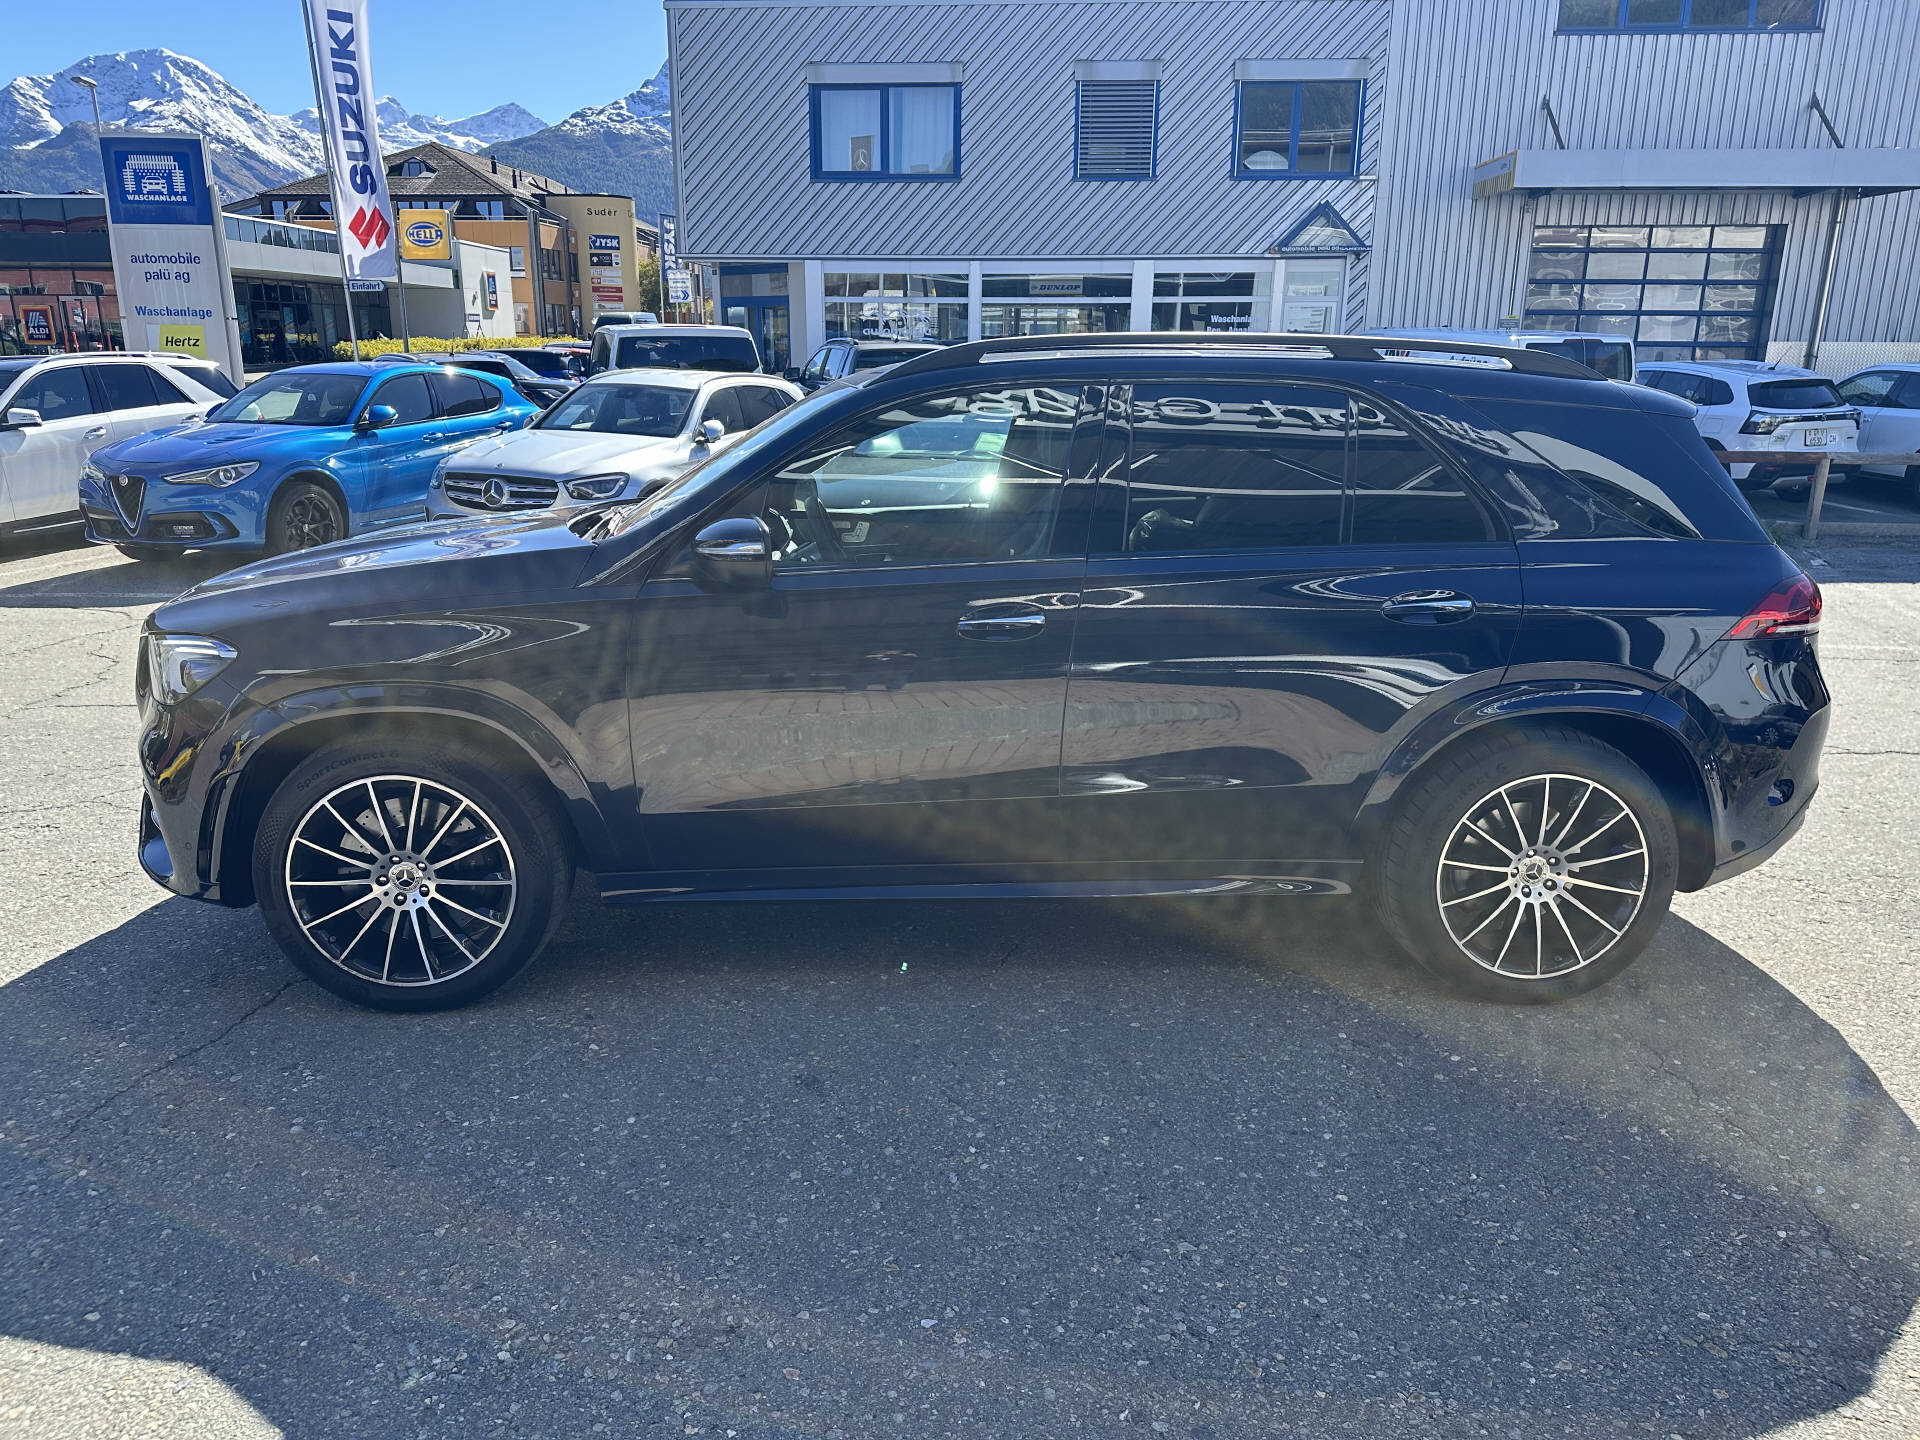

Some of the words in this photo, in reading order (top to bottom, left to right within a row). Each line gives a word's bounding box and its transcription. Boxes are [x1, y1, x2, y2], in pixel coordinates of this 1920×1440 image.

[327, 8, 377, 196] SUZUKI
[126, 194, 188, 202] WASCHANLAGE
[408, 229, 443, 241] HELLA
[595, 238, 619, 248] JYSK
[663, 218, 677, 270] JYSK
[130, 252, 201, 265] automobile
[144, 268, 171, 282] palü
[174, 271, 191, 283] ag
[351, 281, 381, 290] Einfahrt
[134, 305, 213, 319] Waschanlage
[29, 327, 49, 335] ALDI
[165, 336, 201, 347] Hertz
